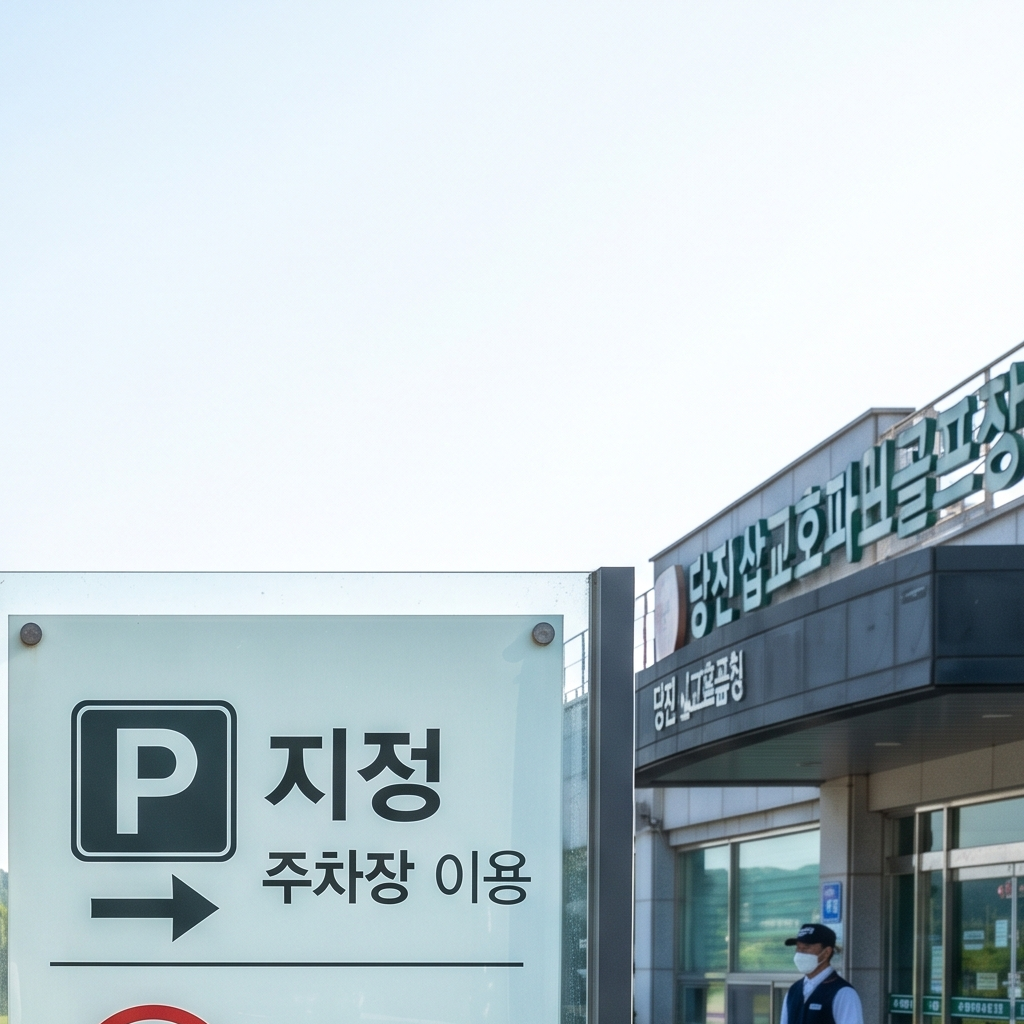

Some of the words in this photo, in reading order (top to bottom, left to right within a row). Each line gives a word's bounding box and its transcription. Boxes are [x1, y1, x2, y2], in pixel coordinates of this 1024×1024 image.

[116, 728, 198, 835] P
[264, 727, 441, 822] 지정
[262, 849, 415, 905] 주차장
[435, 850, 532, 905] 이용
